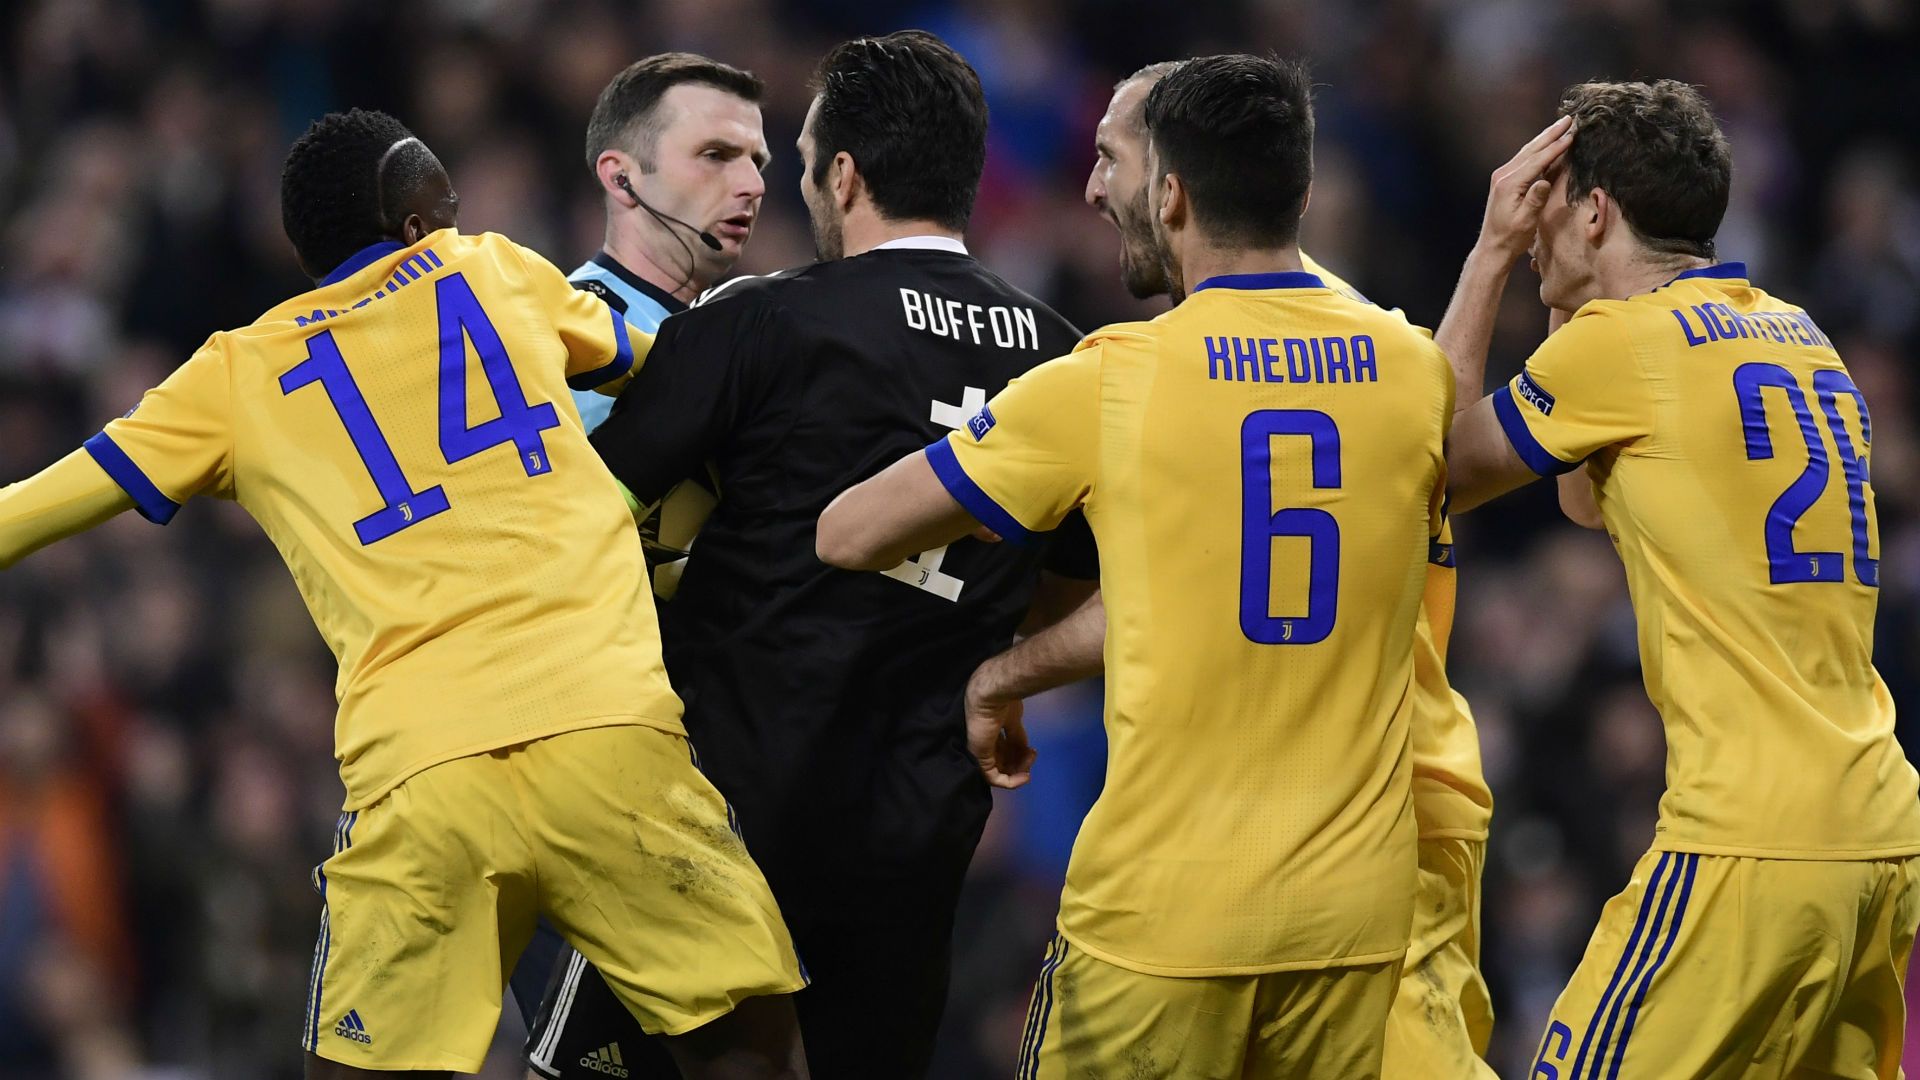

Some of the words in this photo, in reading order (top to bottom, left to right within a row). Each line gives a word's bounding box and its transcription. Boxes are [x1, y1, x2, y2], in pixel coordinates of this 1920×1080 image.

[899, 287, 1039, 351] BUFFON
[1204, 334, 1378, 383] KHEDIRA
[278, 271, 560, 546] 14
[1239, 409, 1342, 645] 6
[334, 1026, 372, 1045] adidas
[579, 1056, 629, 1079] adidas
